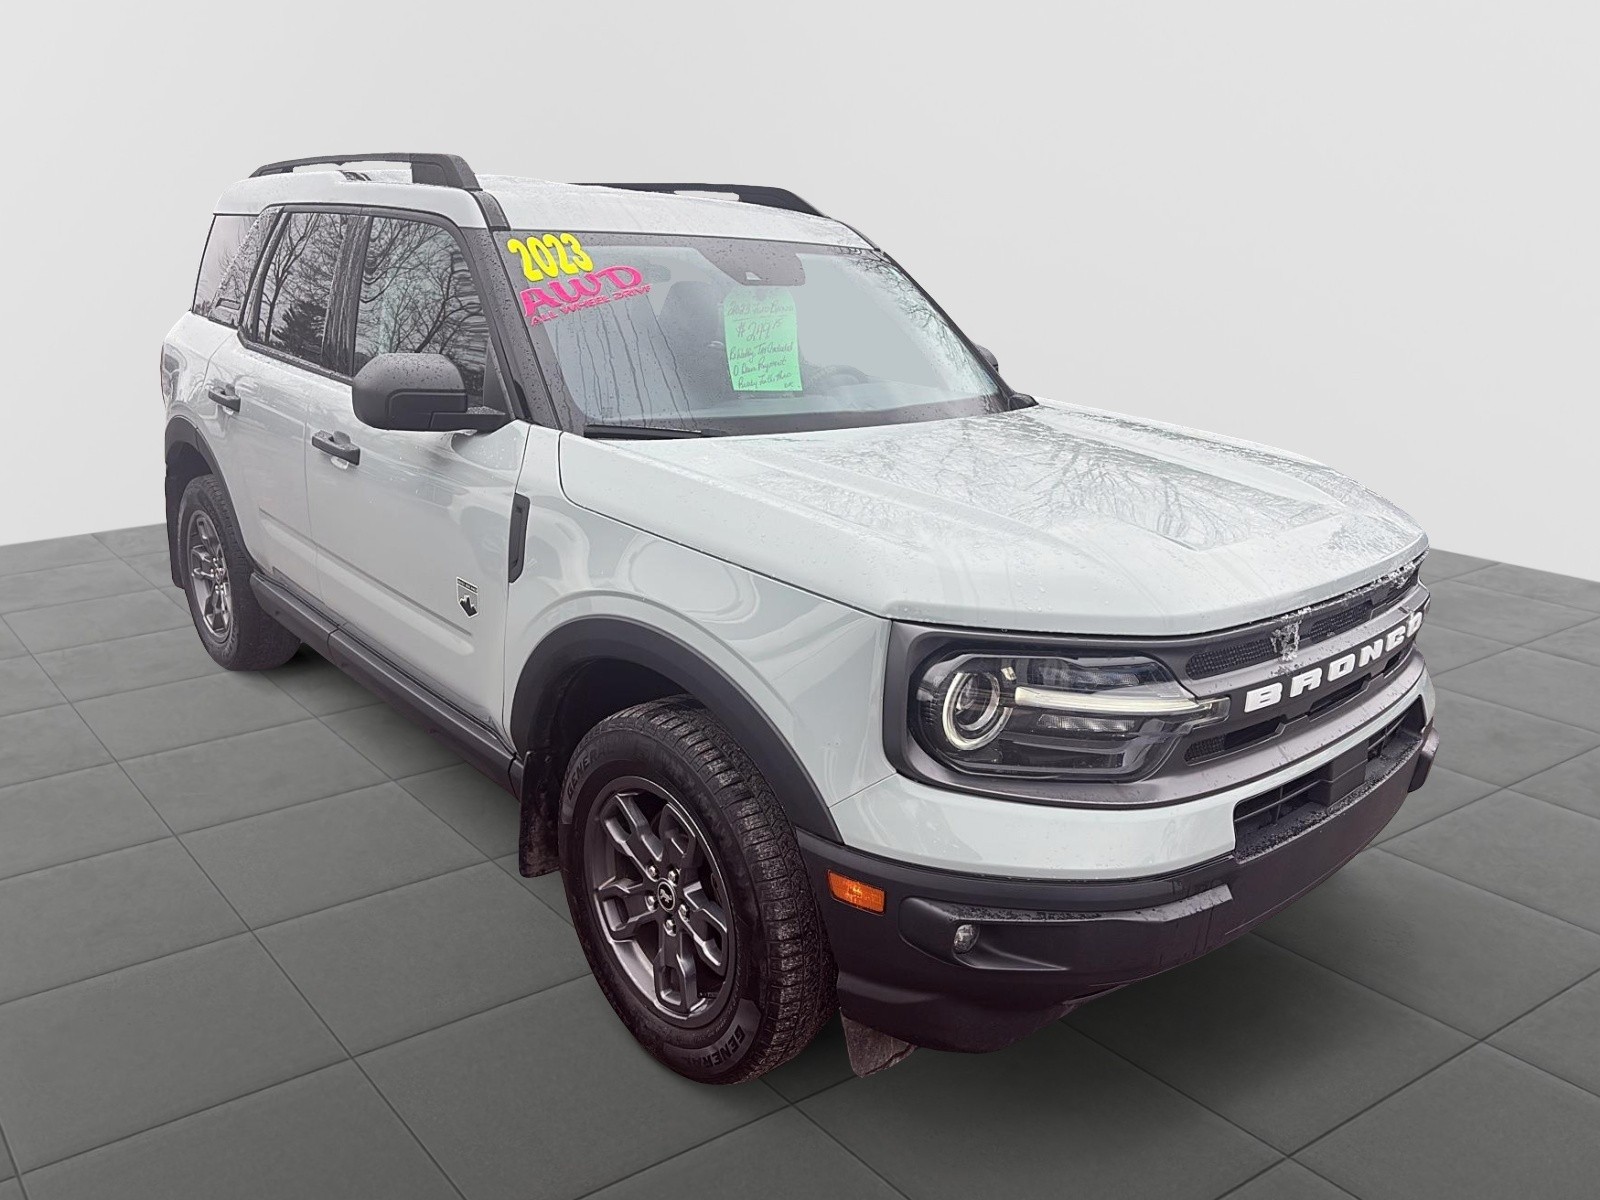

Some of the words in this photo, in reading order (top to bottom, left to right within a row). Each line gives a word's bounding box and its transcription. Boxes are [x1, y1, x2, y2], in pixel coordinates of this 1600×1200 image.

[507, 232, 593, 282] 2023
[520, 265, 643, 317] AWD
[531, 311, 558, 326] ALL
[560, 296, 610, 314] WHEEL
[612, 284, 651, 300] DRIVE
[1244, 612, 1423, 713] BRONCO
